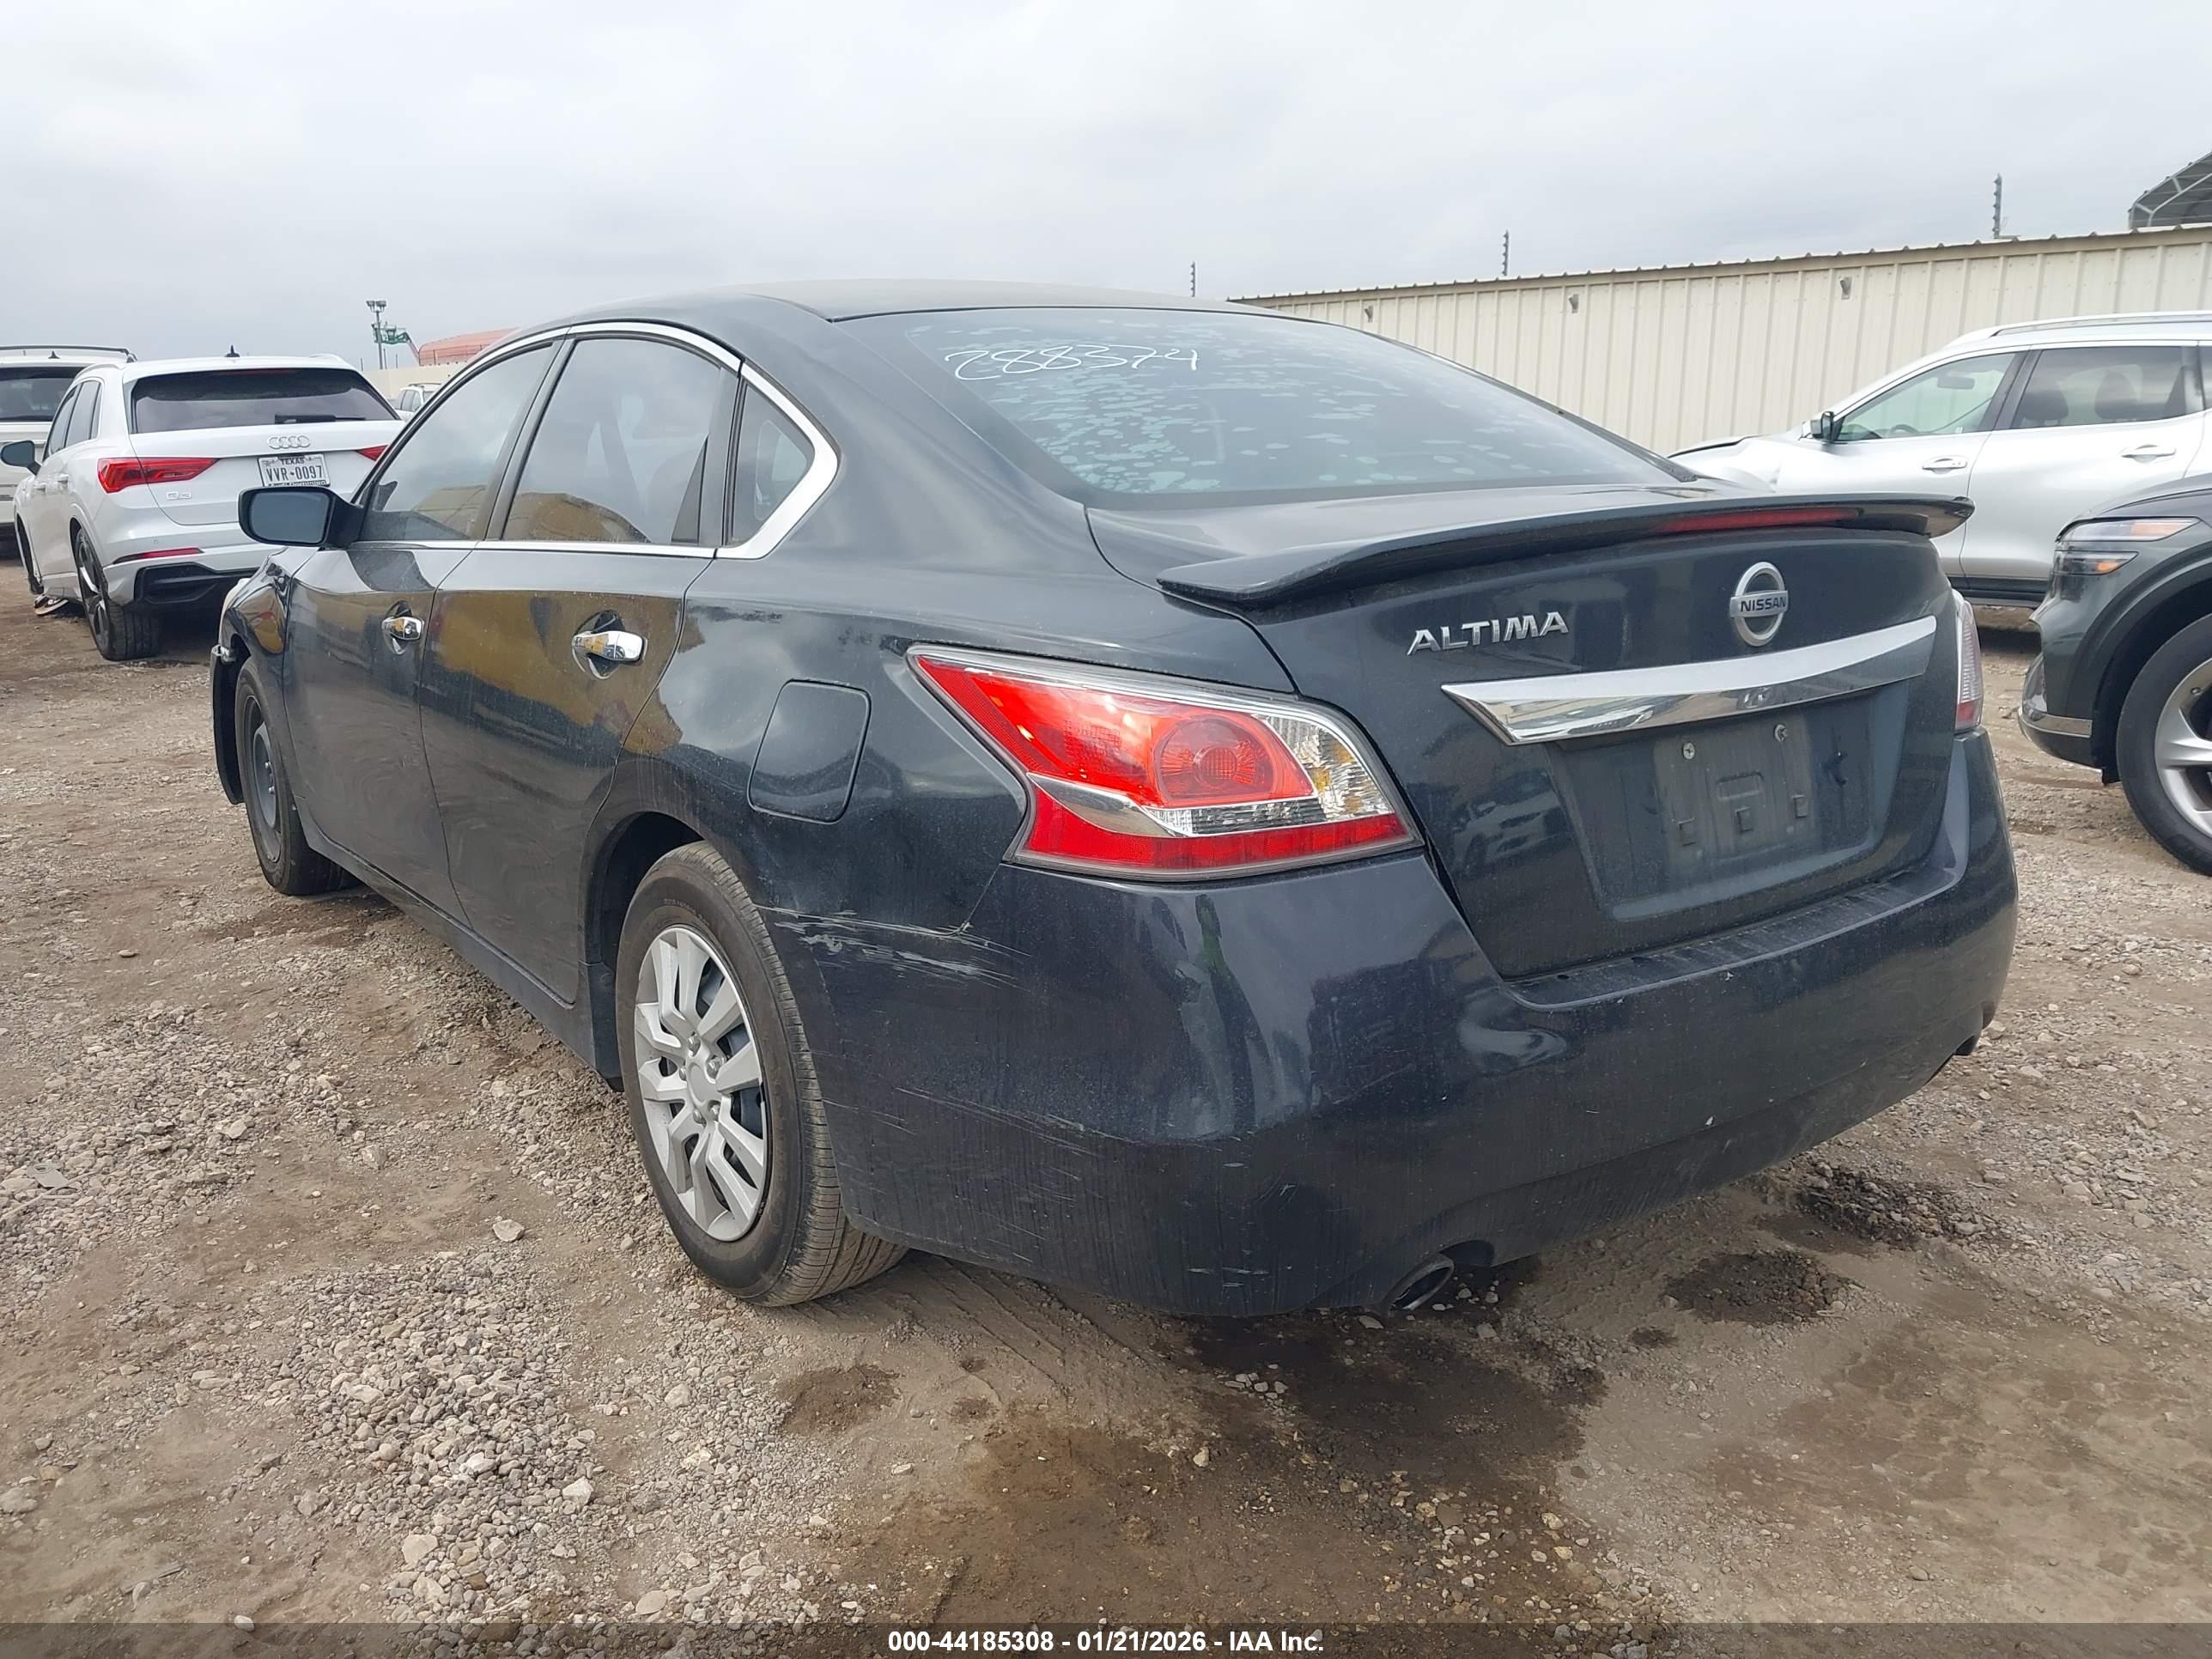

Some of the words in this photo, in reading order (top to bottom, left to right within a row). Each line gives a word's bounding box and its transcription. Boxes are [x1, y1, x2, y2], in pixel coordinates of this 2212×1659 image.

[945, 343, 1200, 380] 288374
[281, 457, 305, 465] TEXAS
[1741, 597, 1786, 611] NISSAN
[1407, 611, 1569, 656] ALTIMA
